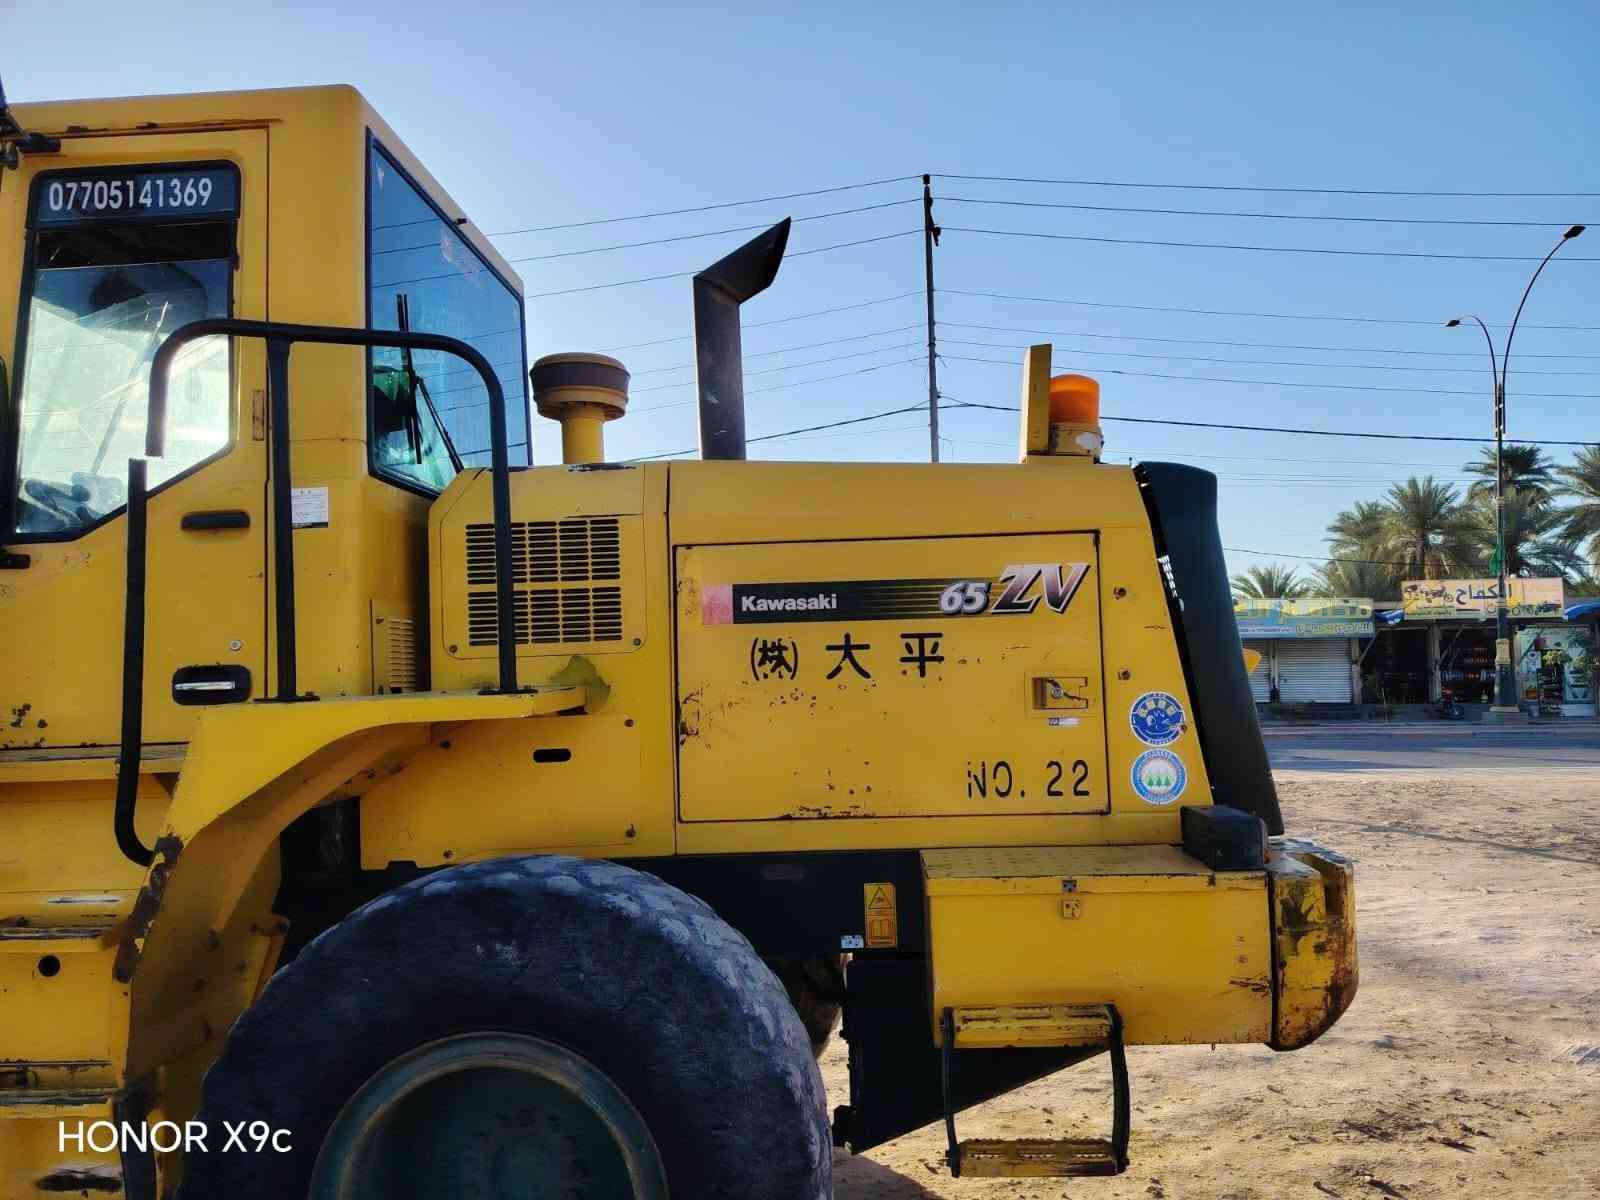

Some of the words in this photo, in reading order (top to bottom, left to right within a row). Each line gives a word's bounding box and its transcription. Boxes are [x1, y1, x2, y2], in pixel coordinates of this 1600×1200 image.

[49, 177, 213, 211] 07705141369
[741, 593, 838, 612] Kawasaki
[939, 581, 990, 615] 65
[991, 562, 1091, 614] ZV
[1046, 759, 1090, 797] 22
